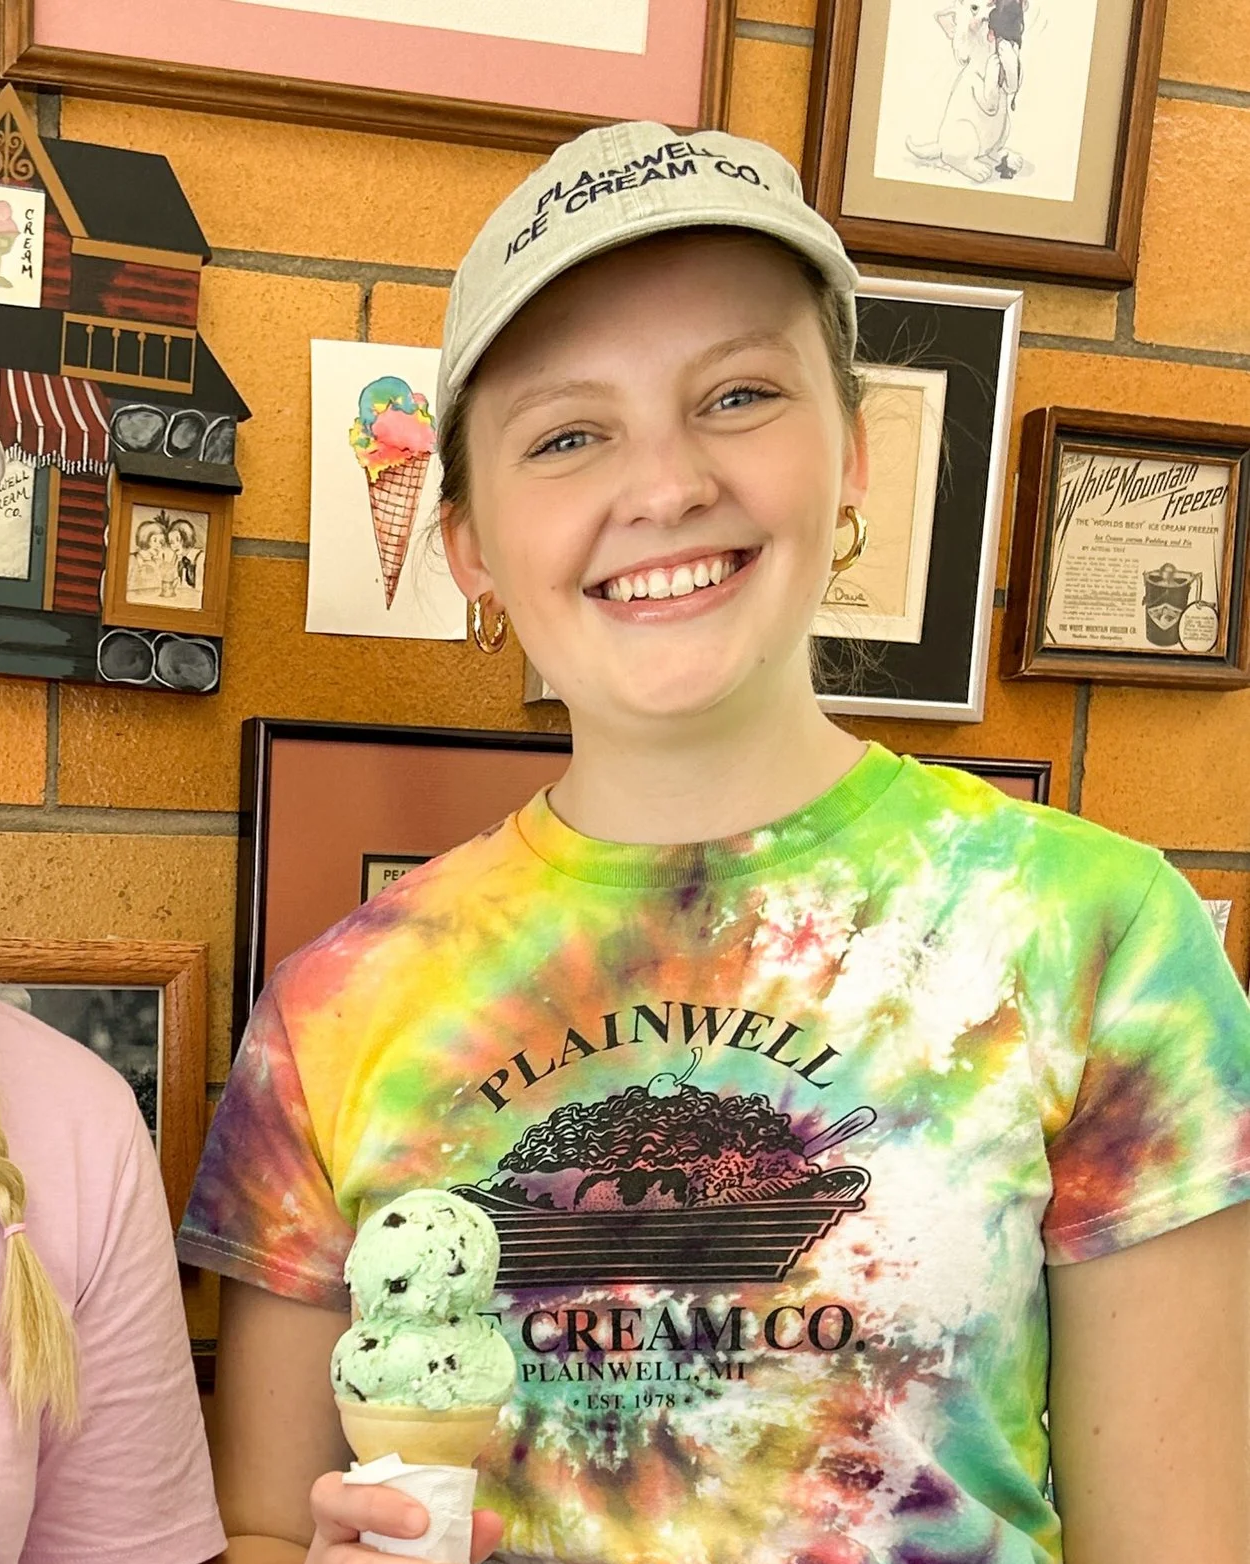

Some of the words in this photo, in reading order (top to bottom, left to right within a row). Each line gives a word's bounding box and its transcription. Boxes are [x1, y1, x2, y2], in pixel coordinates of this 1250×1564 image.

[535, 142, 727, 216] PLAINWELL
[504, 211, 549, 264] ICE
[565, 159, 697, 216] CREAM
[714, 159, 770, 191] CO.
[5, 508, 22, 518] CO.
[1056, 456, 1121, 547] White
[1103, 460, 1199, 516] Mountain
[475, 1000, 843, 1114] PLAINWELL
[521, 1306, 746, 1353] CREAM
[764, 1304, 866, 1352] CO.
[522, 1362, 699, 1384] PLAINWELL,
[709, 1362, 748, 1381] MI
[587, 1394, 626, 1410] EST.
[634, 1394, 676, 1409] 1978
